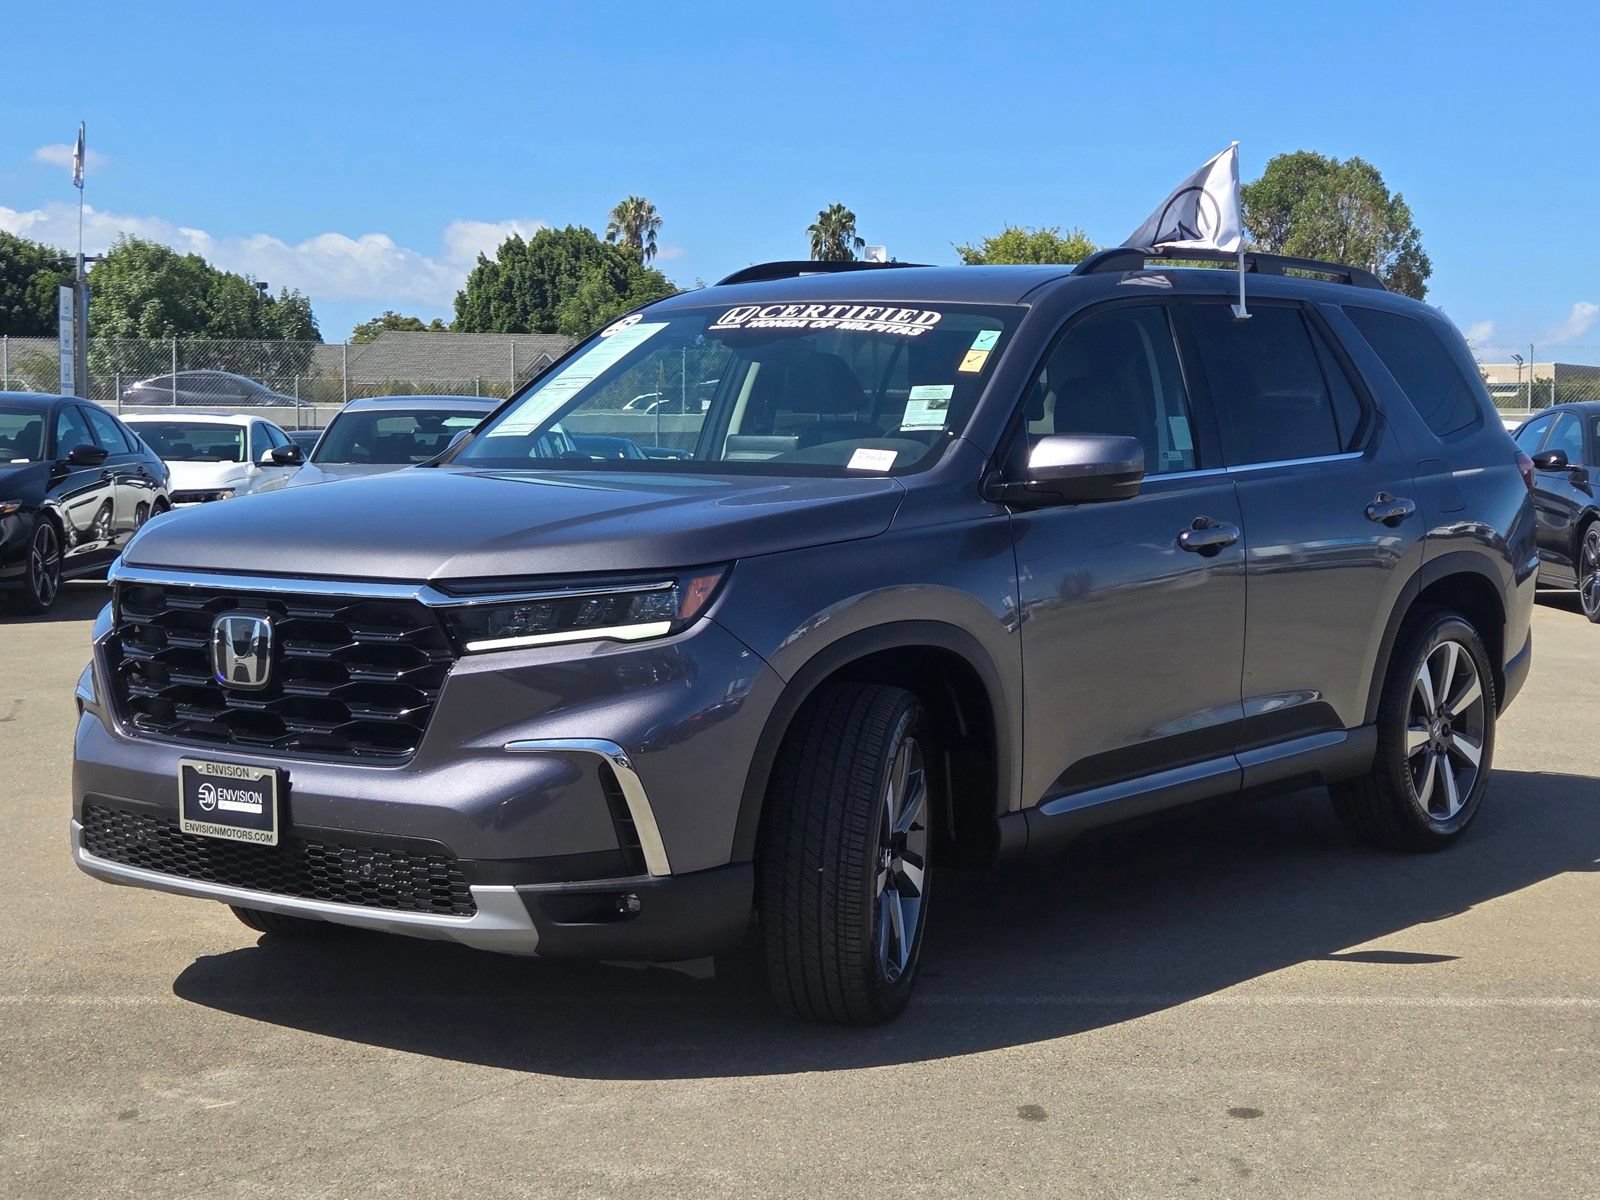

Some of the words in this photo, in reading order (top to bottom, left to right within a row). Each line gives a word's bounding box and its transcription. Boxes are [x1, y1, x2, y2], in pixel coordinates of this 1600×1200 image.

[758, 303, 942, 326] CERTIFIED
[745, 319, 810, 329] HONDA
[809, 319, 838, 329] OF
[835, 321, 926, 336] MILPITAS
[206, 763, 250, 778] ENVISION
[217, 787, 263, 804] ENVISION
[184, 822, 273, 843] ENVISIONMOTORS.COM
